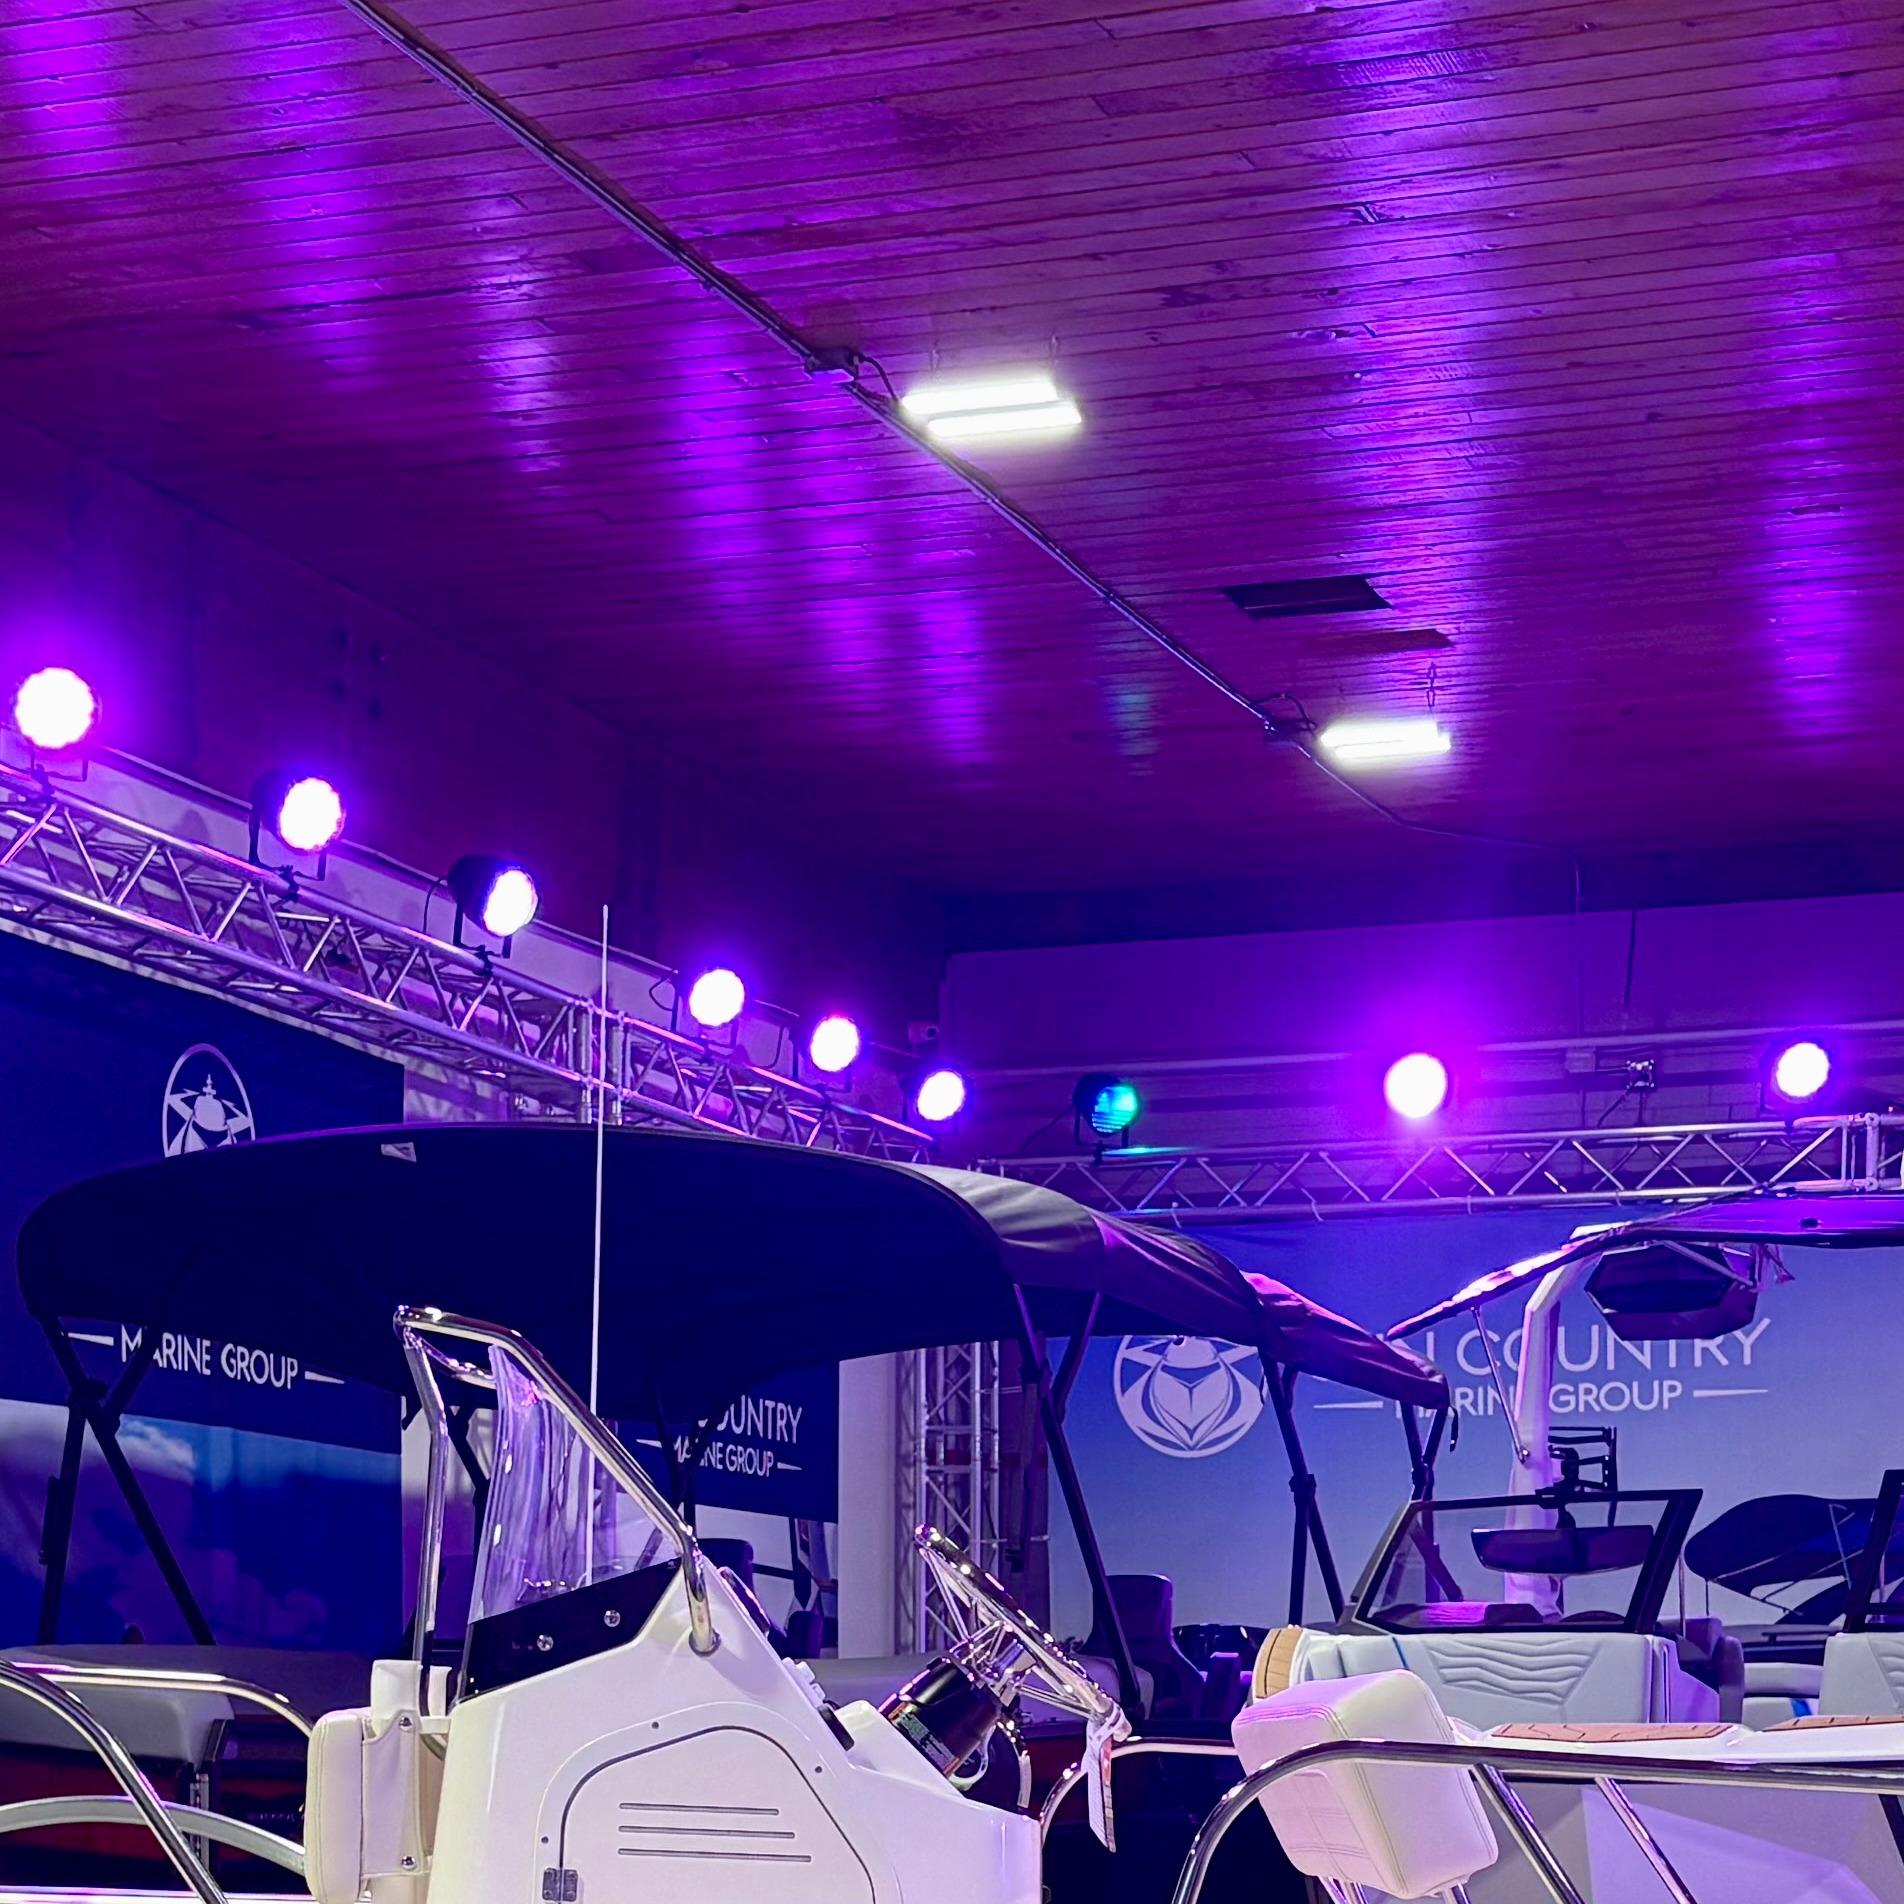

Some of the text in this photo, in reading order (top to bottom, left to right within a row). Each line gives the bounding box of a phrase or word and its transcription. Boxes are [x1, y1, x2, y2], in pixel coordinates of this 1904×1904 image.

[220, 1342, 298, 1390] GROUP
[1548, 1379, 1683, 1414] GROUP
[698, 1394, 803, 1444] UNTRY
[726, 1444, 775, 1478] GROUP
